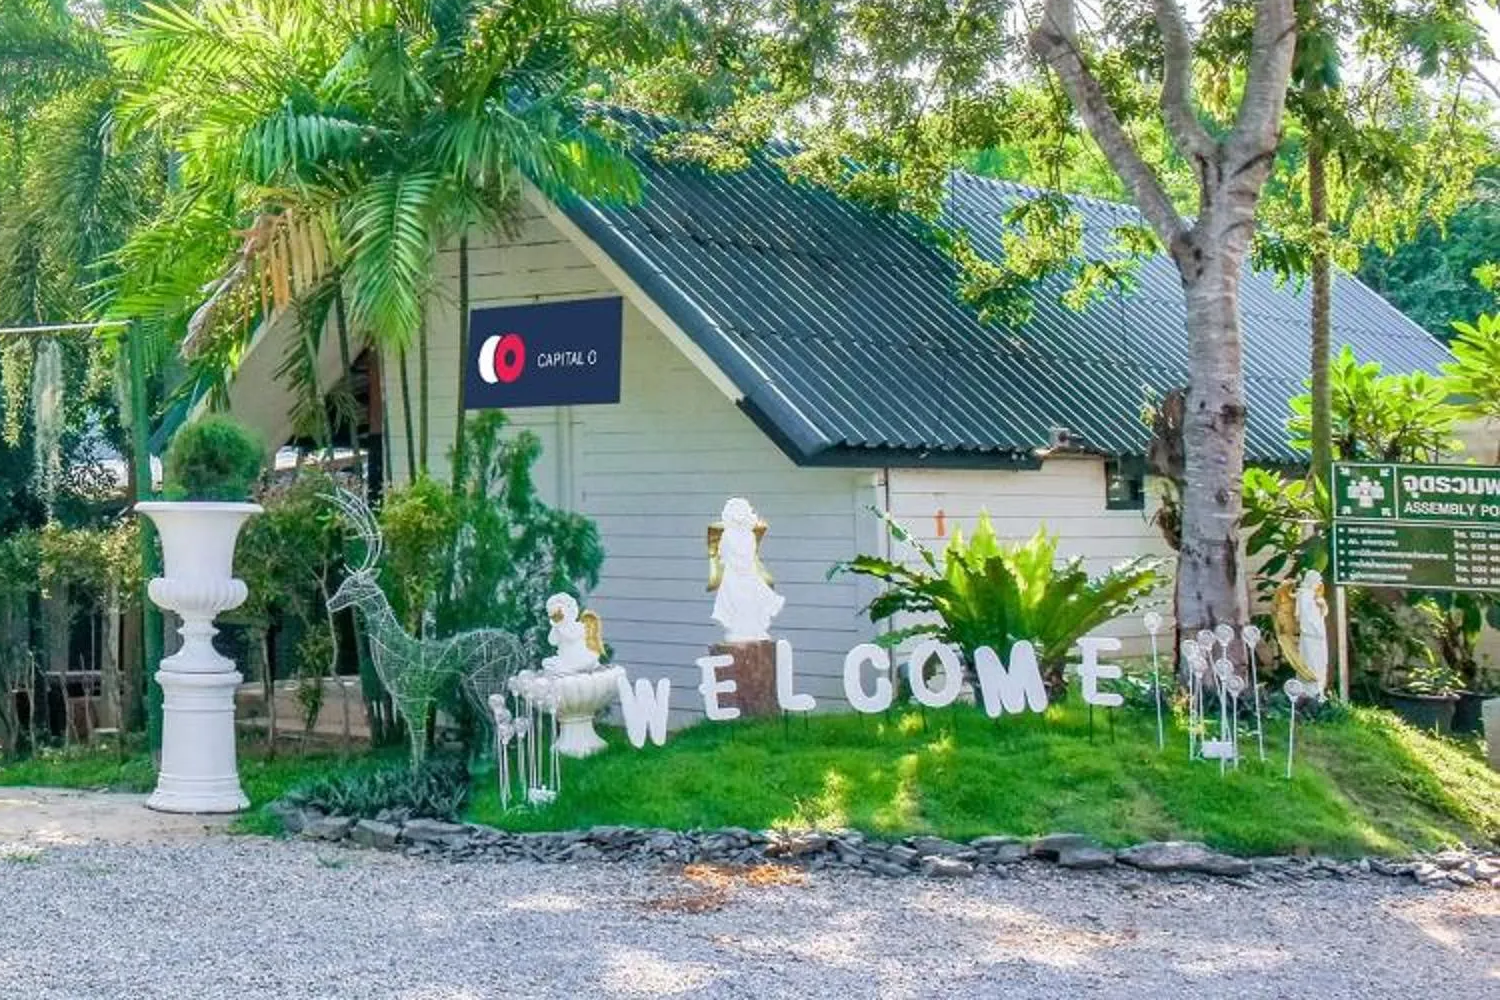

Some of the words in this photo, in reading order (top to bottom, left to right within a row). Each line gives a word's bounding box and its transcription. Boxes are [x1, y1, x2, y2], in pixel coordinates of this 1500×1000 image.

[537, 351, 584, 369] CAPITAL
[587, 349, 597, 365] O
[1404, 502, 1477, 517] ASSEMBLY
[617, 639, 1124, 748] WELCOME
